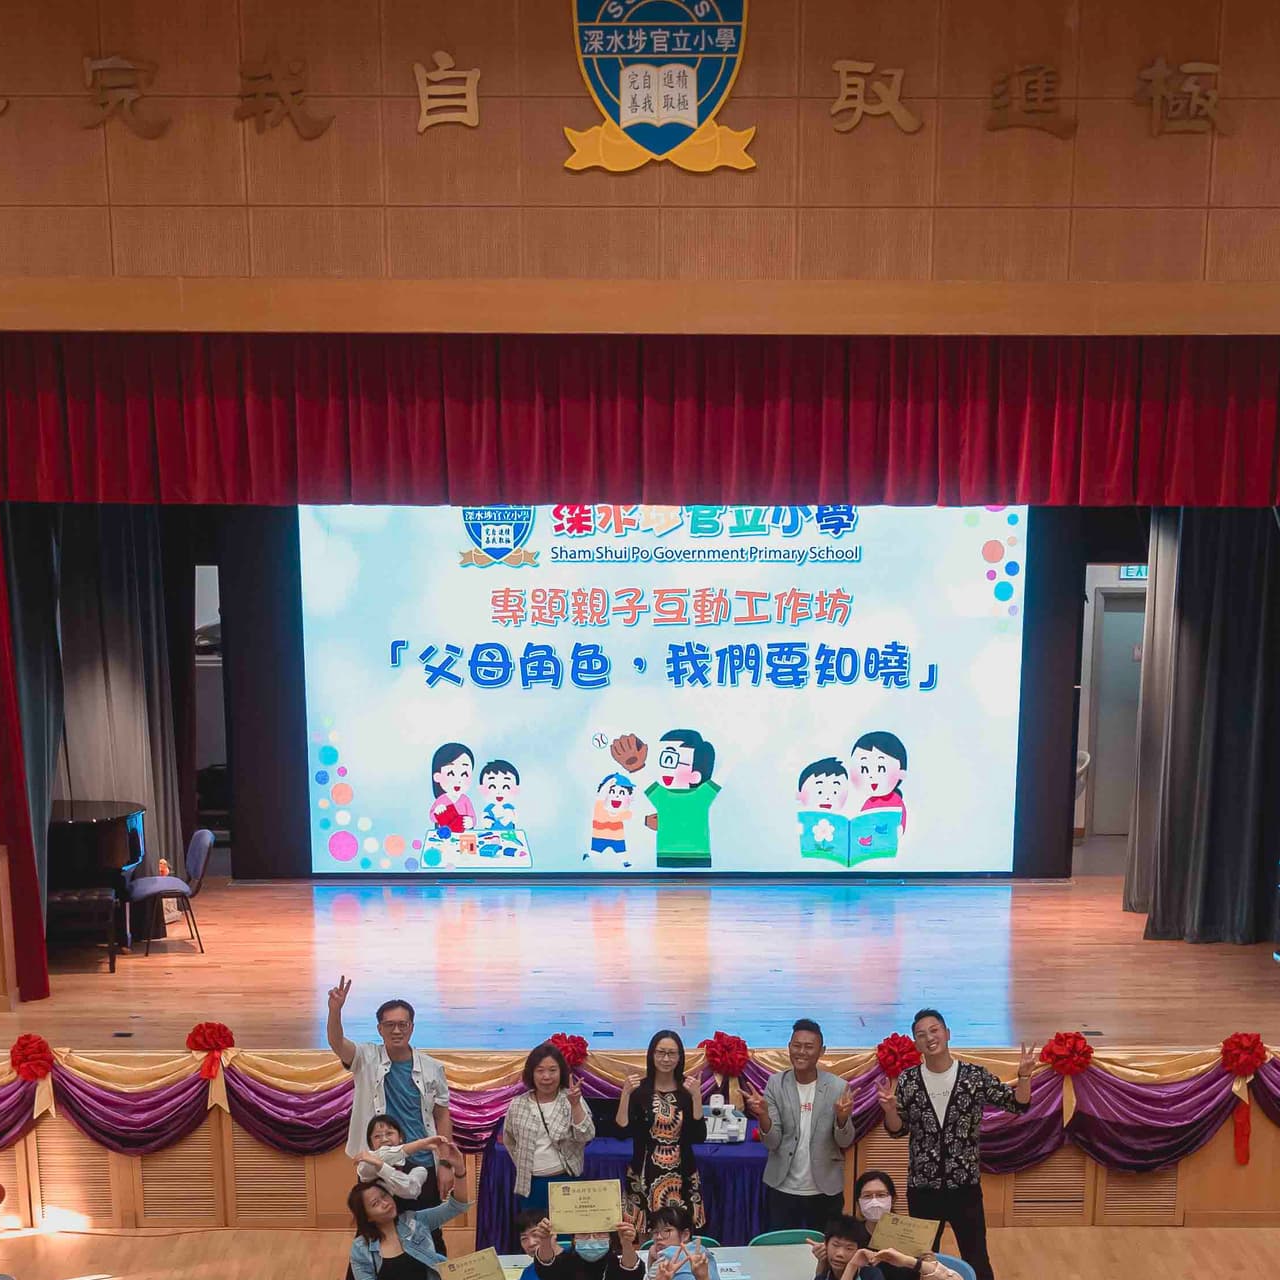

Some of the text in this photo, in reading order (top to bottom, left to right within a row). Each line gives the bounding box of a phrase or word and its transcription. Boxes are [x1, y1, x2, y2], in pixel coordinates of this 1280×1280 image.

[583, 28, 736, 54] 深水埗官立小學
[551, 545, 859, 564] Sham Shui Po Government Primary School
[489, 587, 853, 627] 專題親子互動工作坊
